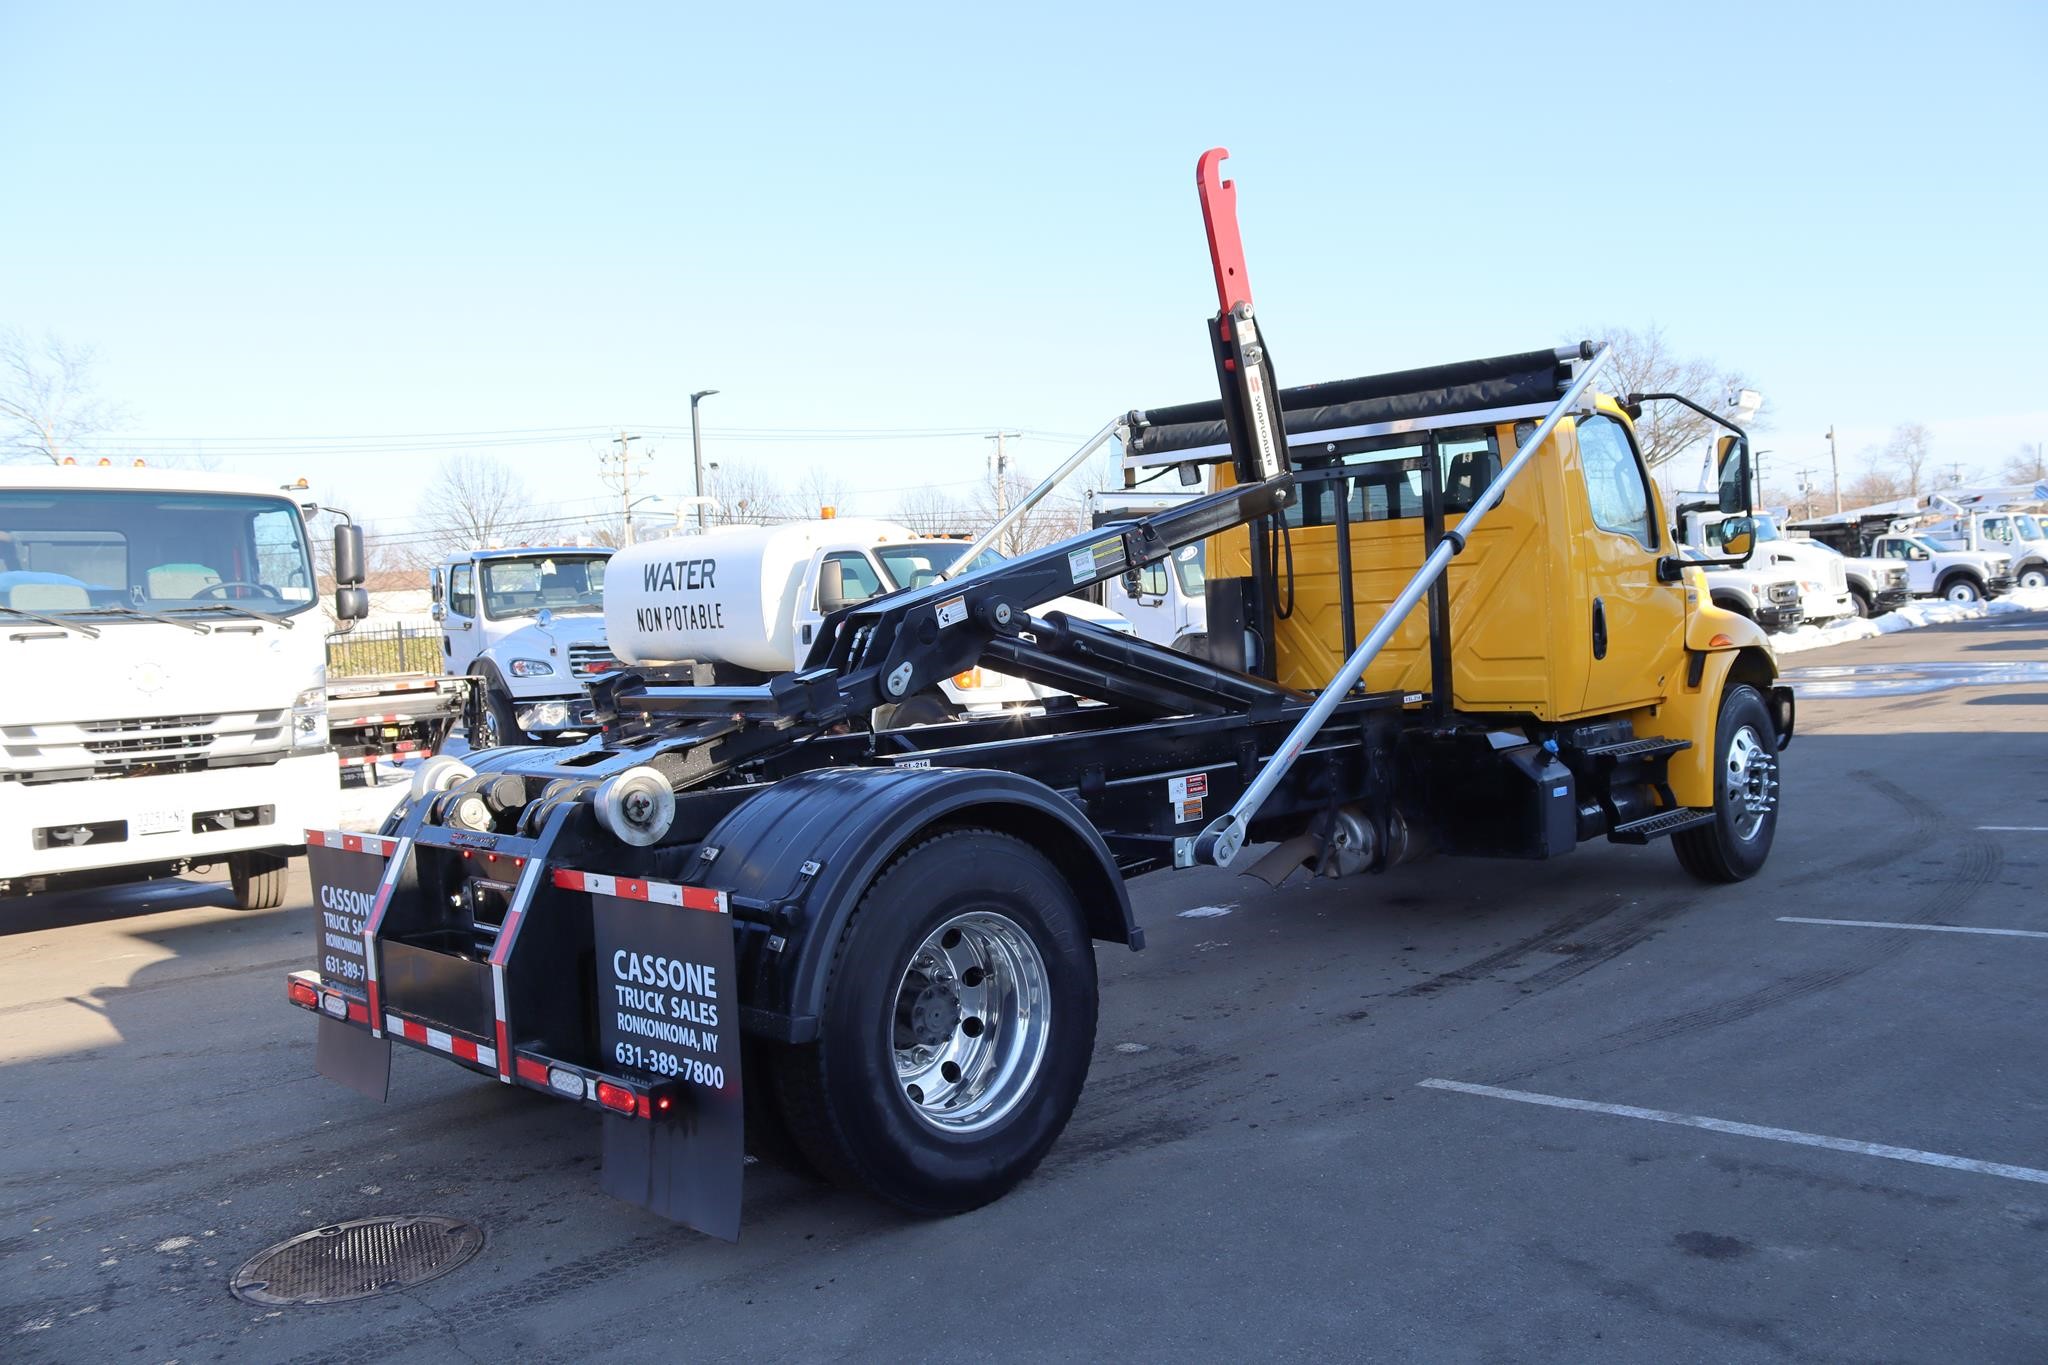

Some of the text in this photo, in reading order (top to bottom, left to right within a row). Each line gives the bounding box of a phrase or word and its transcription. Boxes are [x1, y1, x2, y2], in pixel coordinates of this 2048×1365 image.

[1255, 396, 1272, 466] SWAPLOADER
[644, 558, 716, 592] WATER
[637, 603, 724, 632] NON POTABLE
[323, 912, 351, 933] TRUCK
[613, 950, 717, 998] CASSONE
[615, 985, 718, 1026] TRUCK SALES
[618, 1012, 718, 1053] RONKONKOMA, NY
[615, 1042, 724, 1089] 631-389-7800
